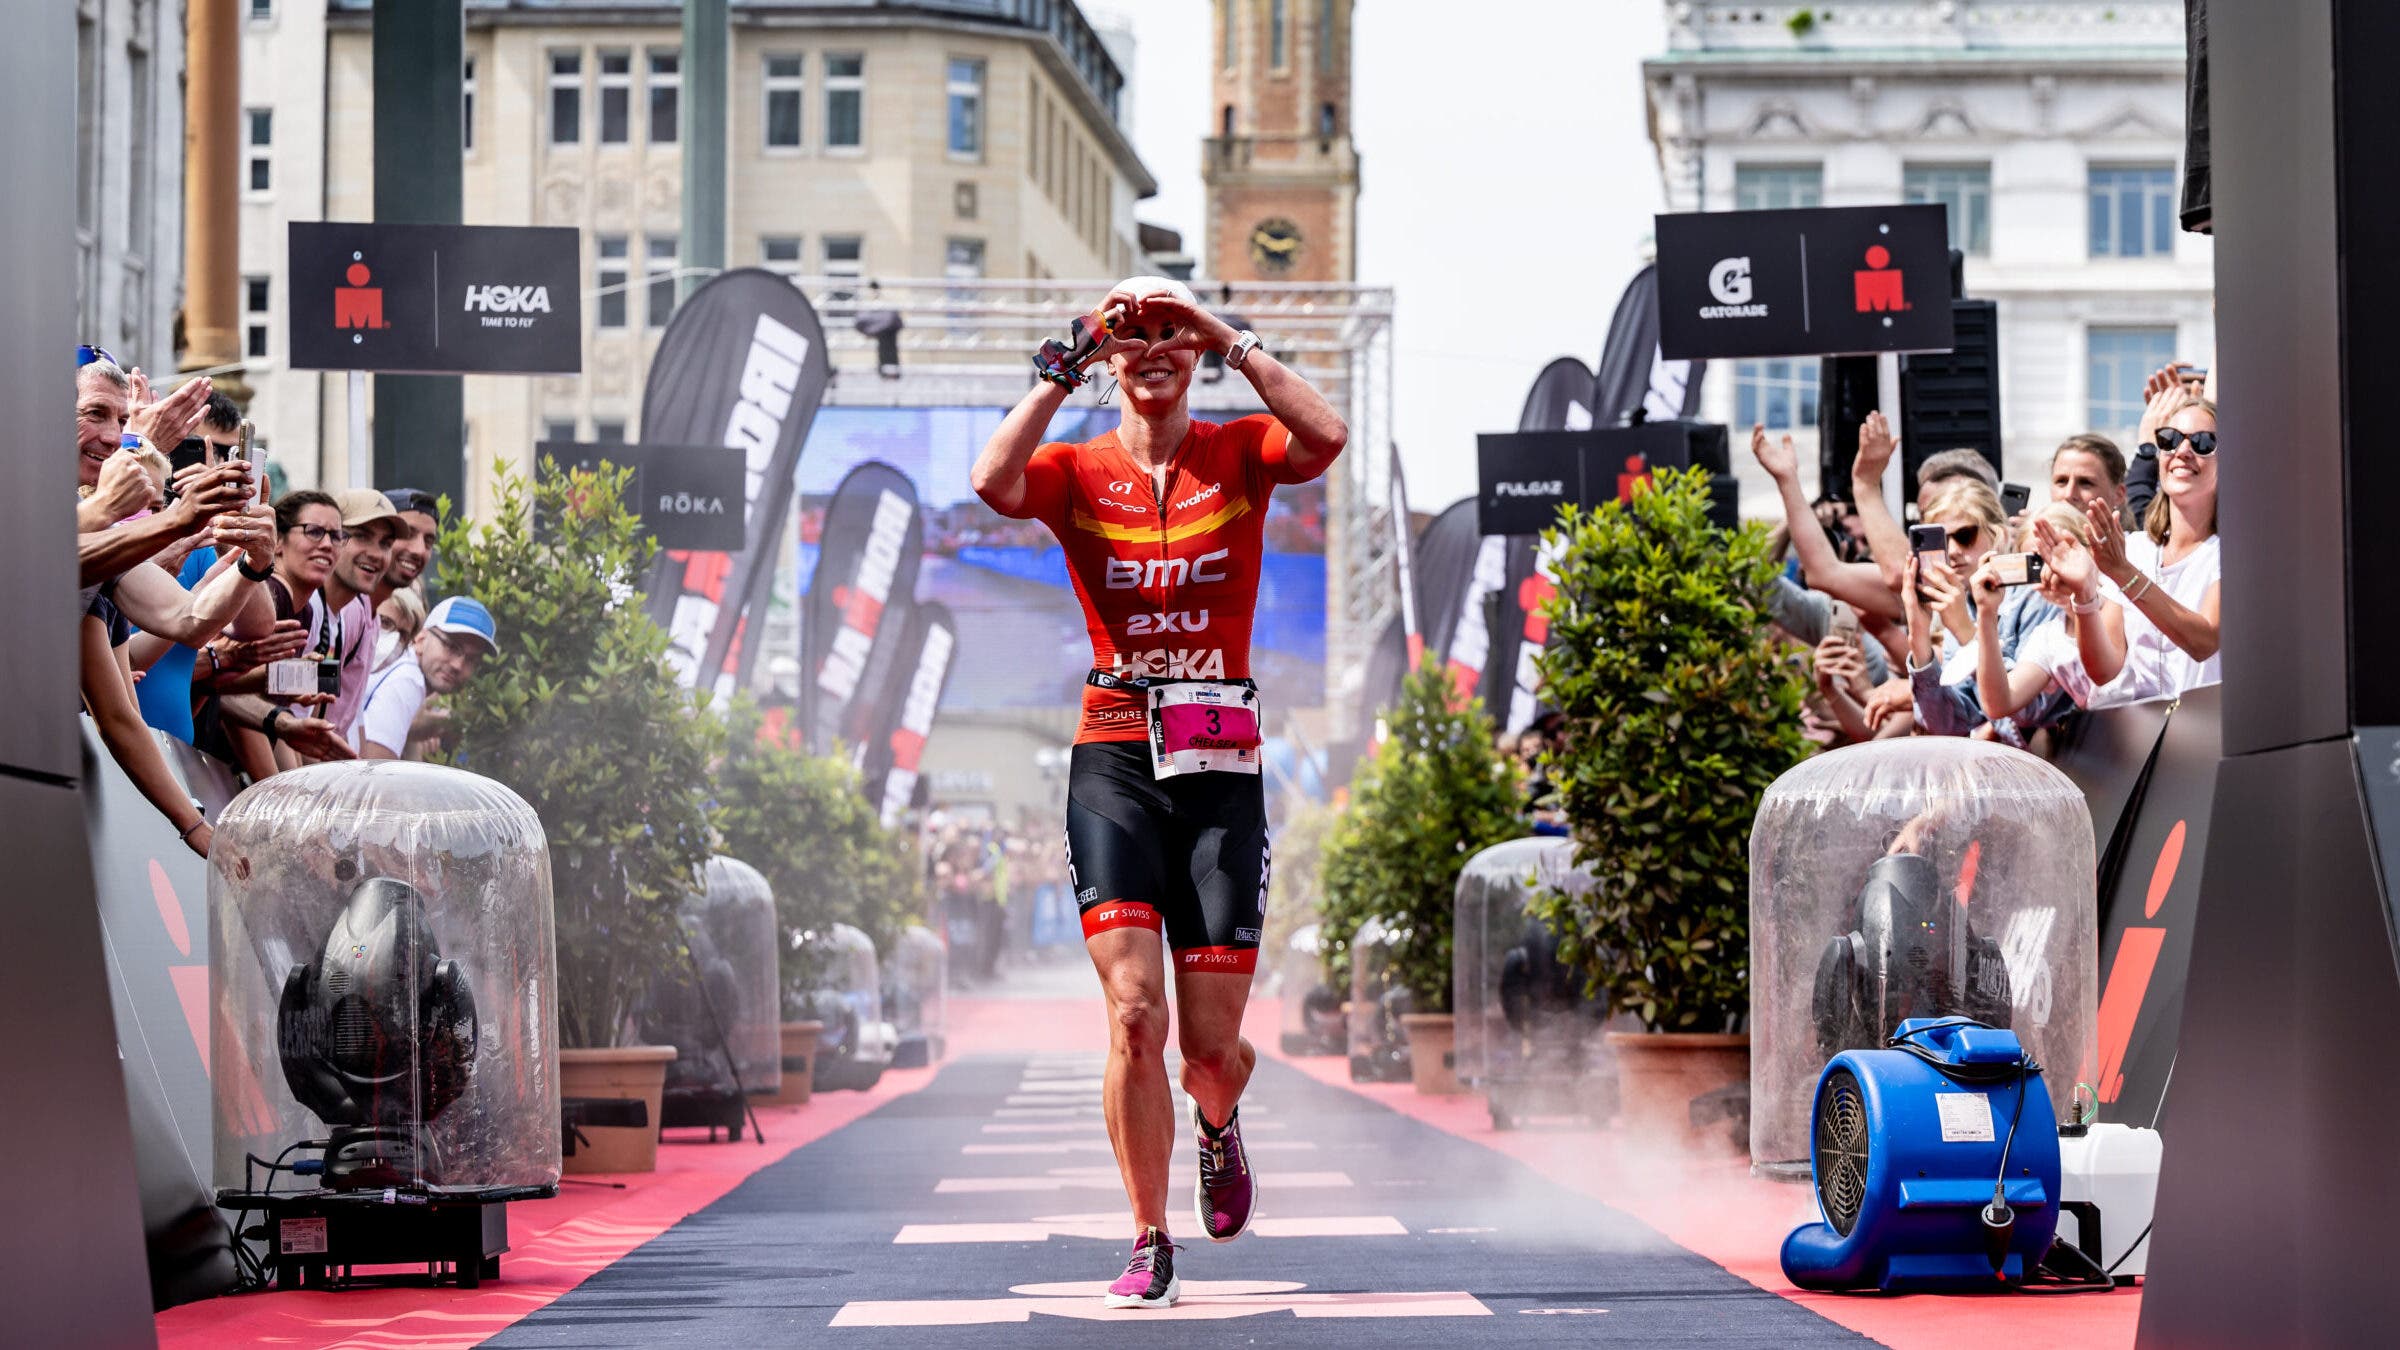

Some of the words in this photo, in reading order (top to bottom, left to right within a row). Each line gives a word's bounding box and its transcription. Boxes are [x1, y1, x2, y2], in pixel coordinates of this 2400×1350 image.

[464, 284, 550, 313] HOKA
[1699, 304, 1769, 319] GATORADE
[481, 316, 504, 328] TIME
[504, 317, 517, 328] TO
[519, 317, 533, 329] FLY
[1175, 482, 1221, 510] wahoo
[1105, 547, 1229, 590] BMC
[1126, 608, 1209, 636] 2XU
[1113, 648, 1227, 680] HOKA
[1098, 710, 1142, 720] ENDURE
[1205, 708, 1222, 736] 3
[1154, 720, 1164, 744] FPRO
[1100, 909, 1118, 922] DT
[1121, 908, 1150, 920] SWISS
[1185, 953, 1201, 963] DT
[1203, 954, 1239, 965] SWISS
